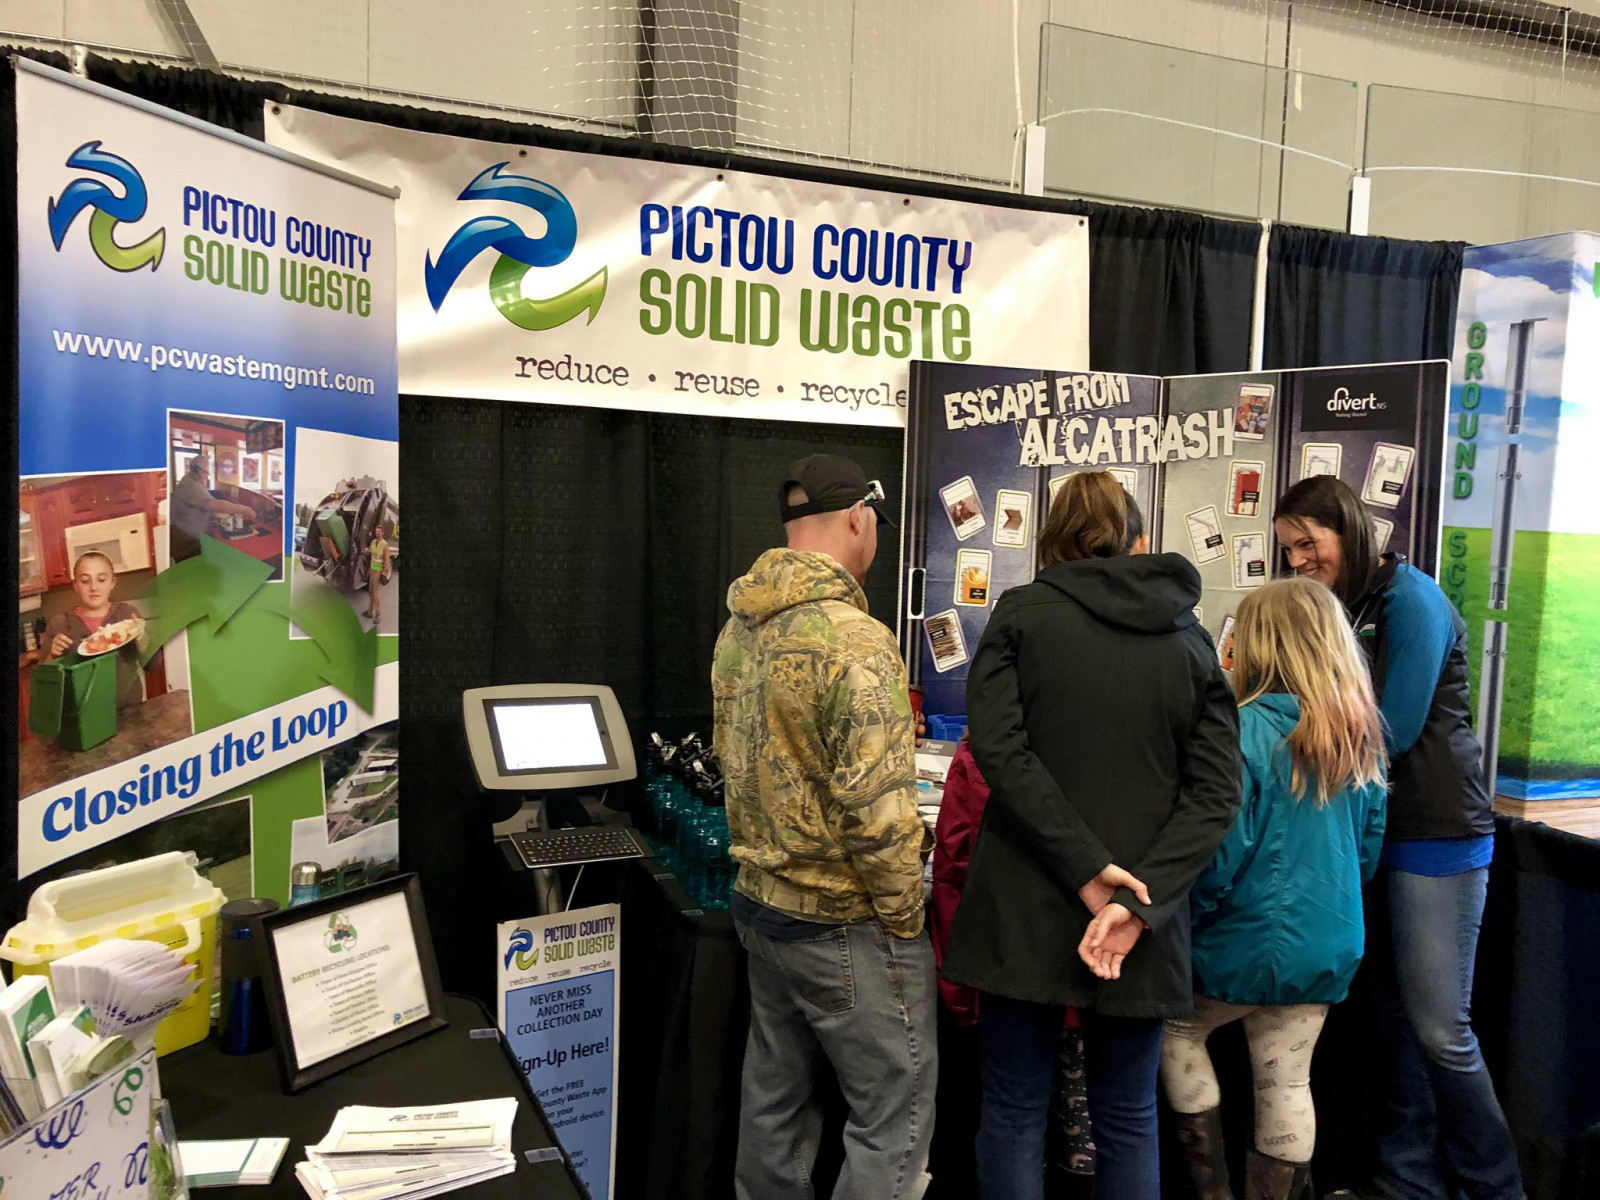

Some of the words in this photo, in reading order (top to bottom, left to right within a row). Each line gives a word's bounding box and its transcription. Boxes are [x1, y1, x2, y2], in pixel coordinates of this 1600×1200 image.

[184, 186, 275, 247] PICTOU
[286, 216, 371, 272] COUNTY
[640, 203, 794, 275] PICTOU
[813, 223, 972, 294] COUNTY
[184, 234, 269, 295] SOLID
[639, 268, 780, 347] SOLID
[52, 330, 375, 395] www.pcwastemgmt.com
[515, 354, 629, 386] reduce
[674, 369, 760, 397] reuse
[943, 379, 1050, 430] ESCAPE
[1055, 374, 1131, 414] FROM
[1453, 321, 1486, 500] GROUND
[1016, 407, 1233, 466] ALCATRASH
[42, 753, 201, 842] Closing
[208, 732, 265, 777] the
[271, 699, 348, 752] Loop
[544, 922, 577, 944] PICTOU
[580, 916, 615, 937] COUNTY
[544, 941, 574, 963] SOLID
[529, 990, 564, 1006] NEVER
[567, 984, 592, 998] MISS
[536, 999, 585, 1018] ANOTHER
[517, 1013, 580, 1035] COLLECTION
[584, 1008, 603, 1020] DAY
[519, 1049, 567, 1076] gn-Up
[571, 1037, 609, 1060] Here!
[541, 1097, 565, 1108] ounty
[566, 1079, 584, 1091] FREE
[552, 1115, 578, 1128] ndroid
